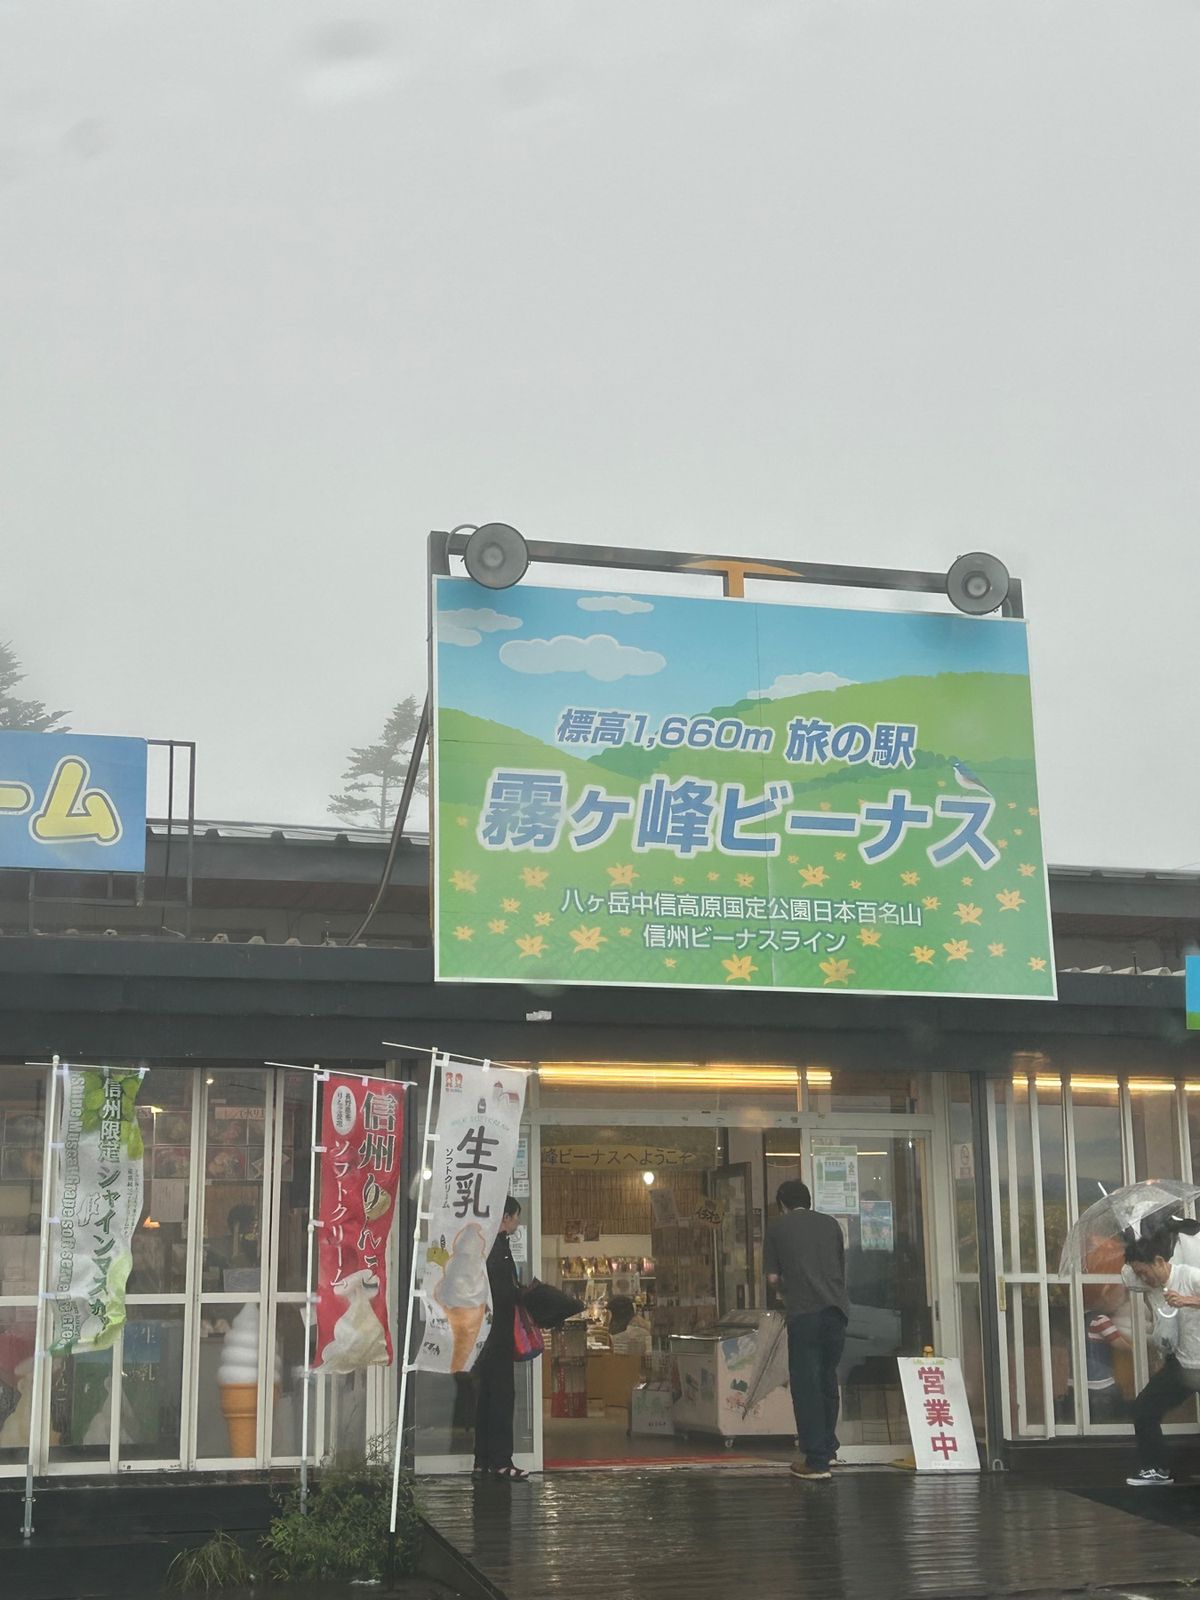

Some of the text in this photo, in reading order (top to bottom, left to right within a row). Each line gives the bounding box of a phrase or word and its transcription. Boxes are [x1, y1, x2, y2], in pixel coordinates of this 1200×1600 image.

[785, 718, 917, 768] 旅の駅
[642, 923, 847, 953] 信州ビーナスライン
[442, 1148, 454, 1209] ソフトクリーム
[453, 1125, 499, 1218] 生乳
[329, 1140, 350, 1289] ソフトクリーム
[917, 1366, 958, 1461] 営業中
